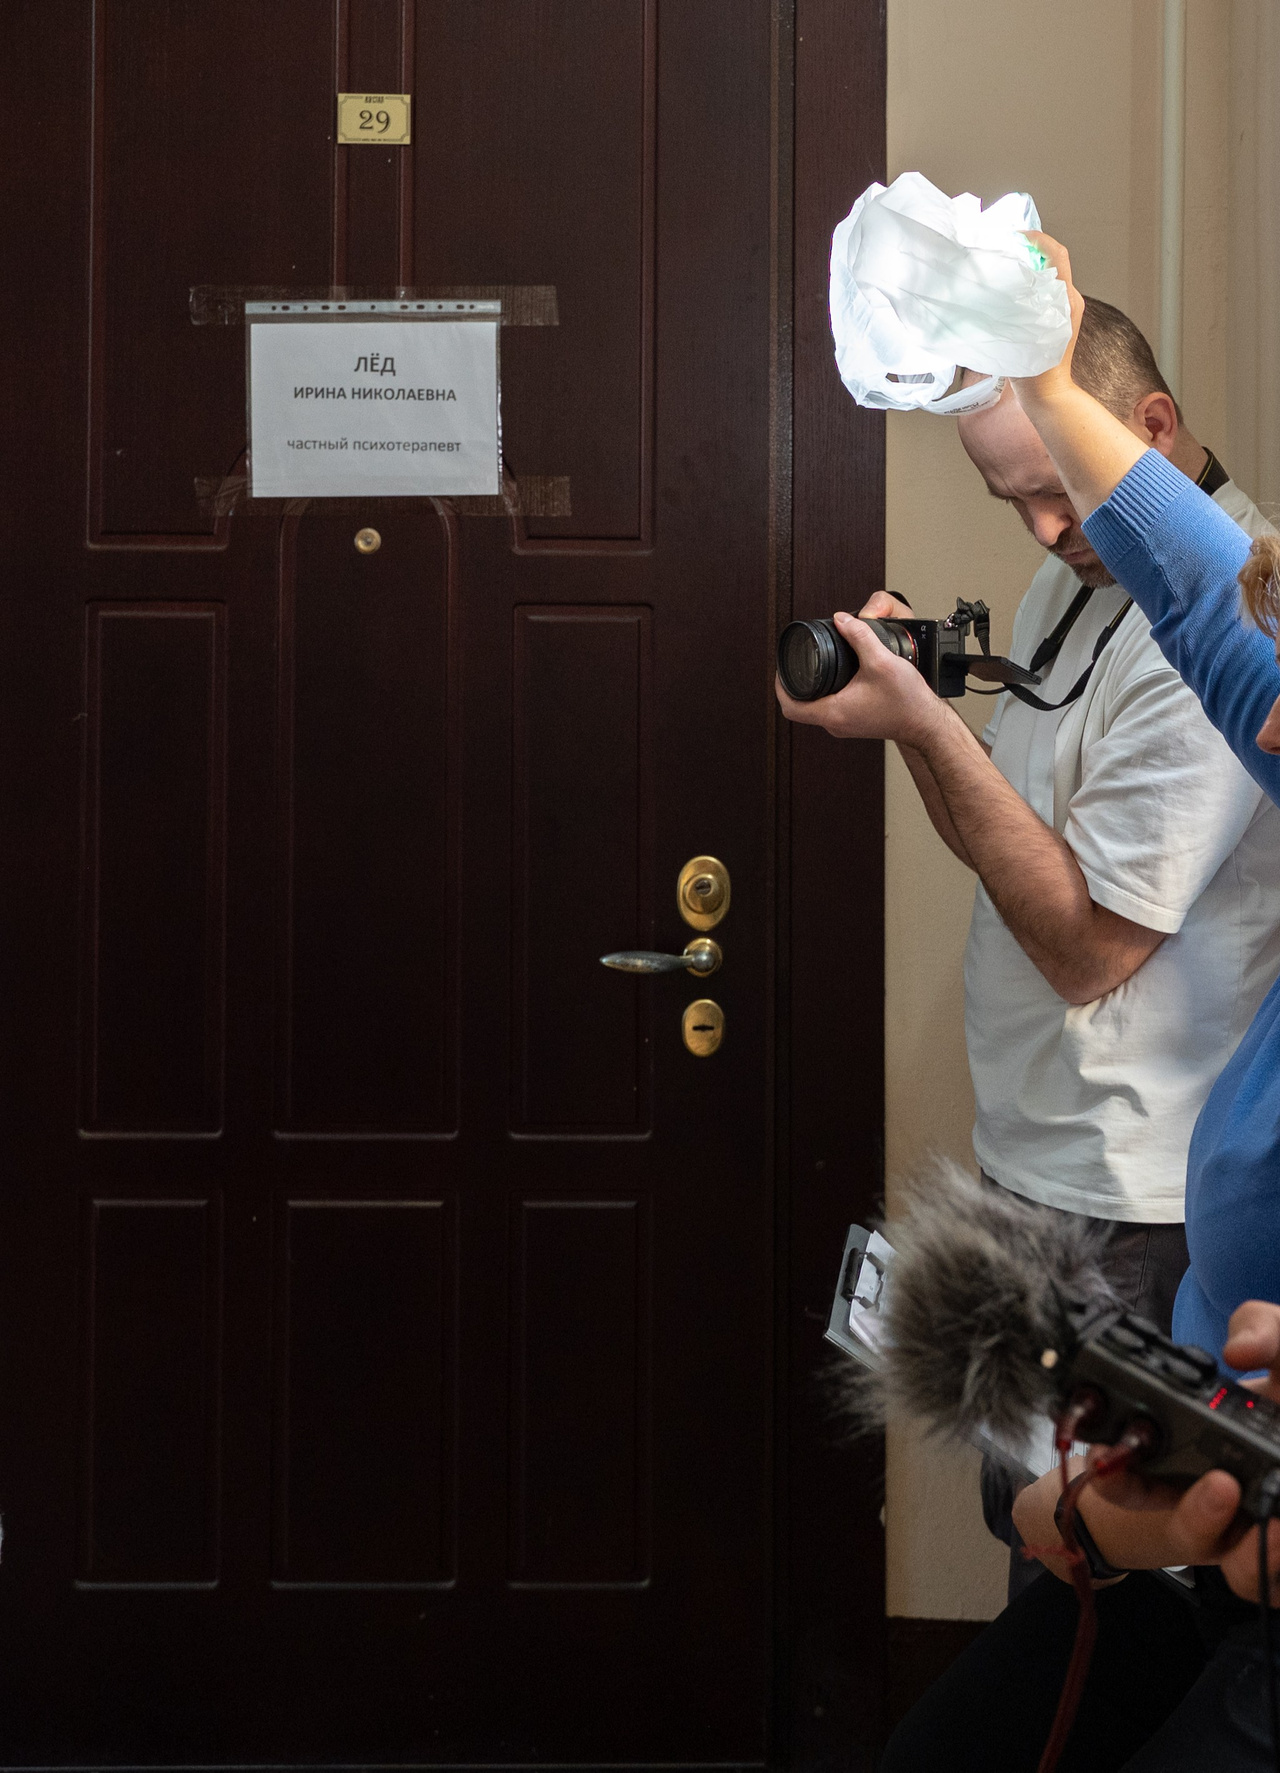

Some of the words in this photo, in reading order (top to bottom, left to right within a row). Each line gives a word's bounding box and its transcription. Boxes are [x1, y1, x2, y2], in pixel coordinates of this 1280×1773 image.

[359, 109, 391, 134] 29
[353, 352, 397, 377] ЛЁД
[293, 386, 347, 400] ИРИНА
[351, 387, 457, 402] НИКОЛАЕВНА
[286, 437, 349, 451] частный
[352, 440, 462, 454] психотерапевт
